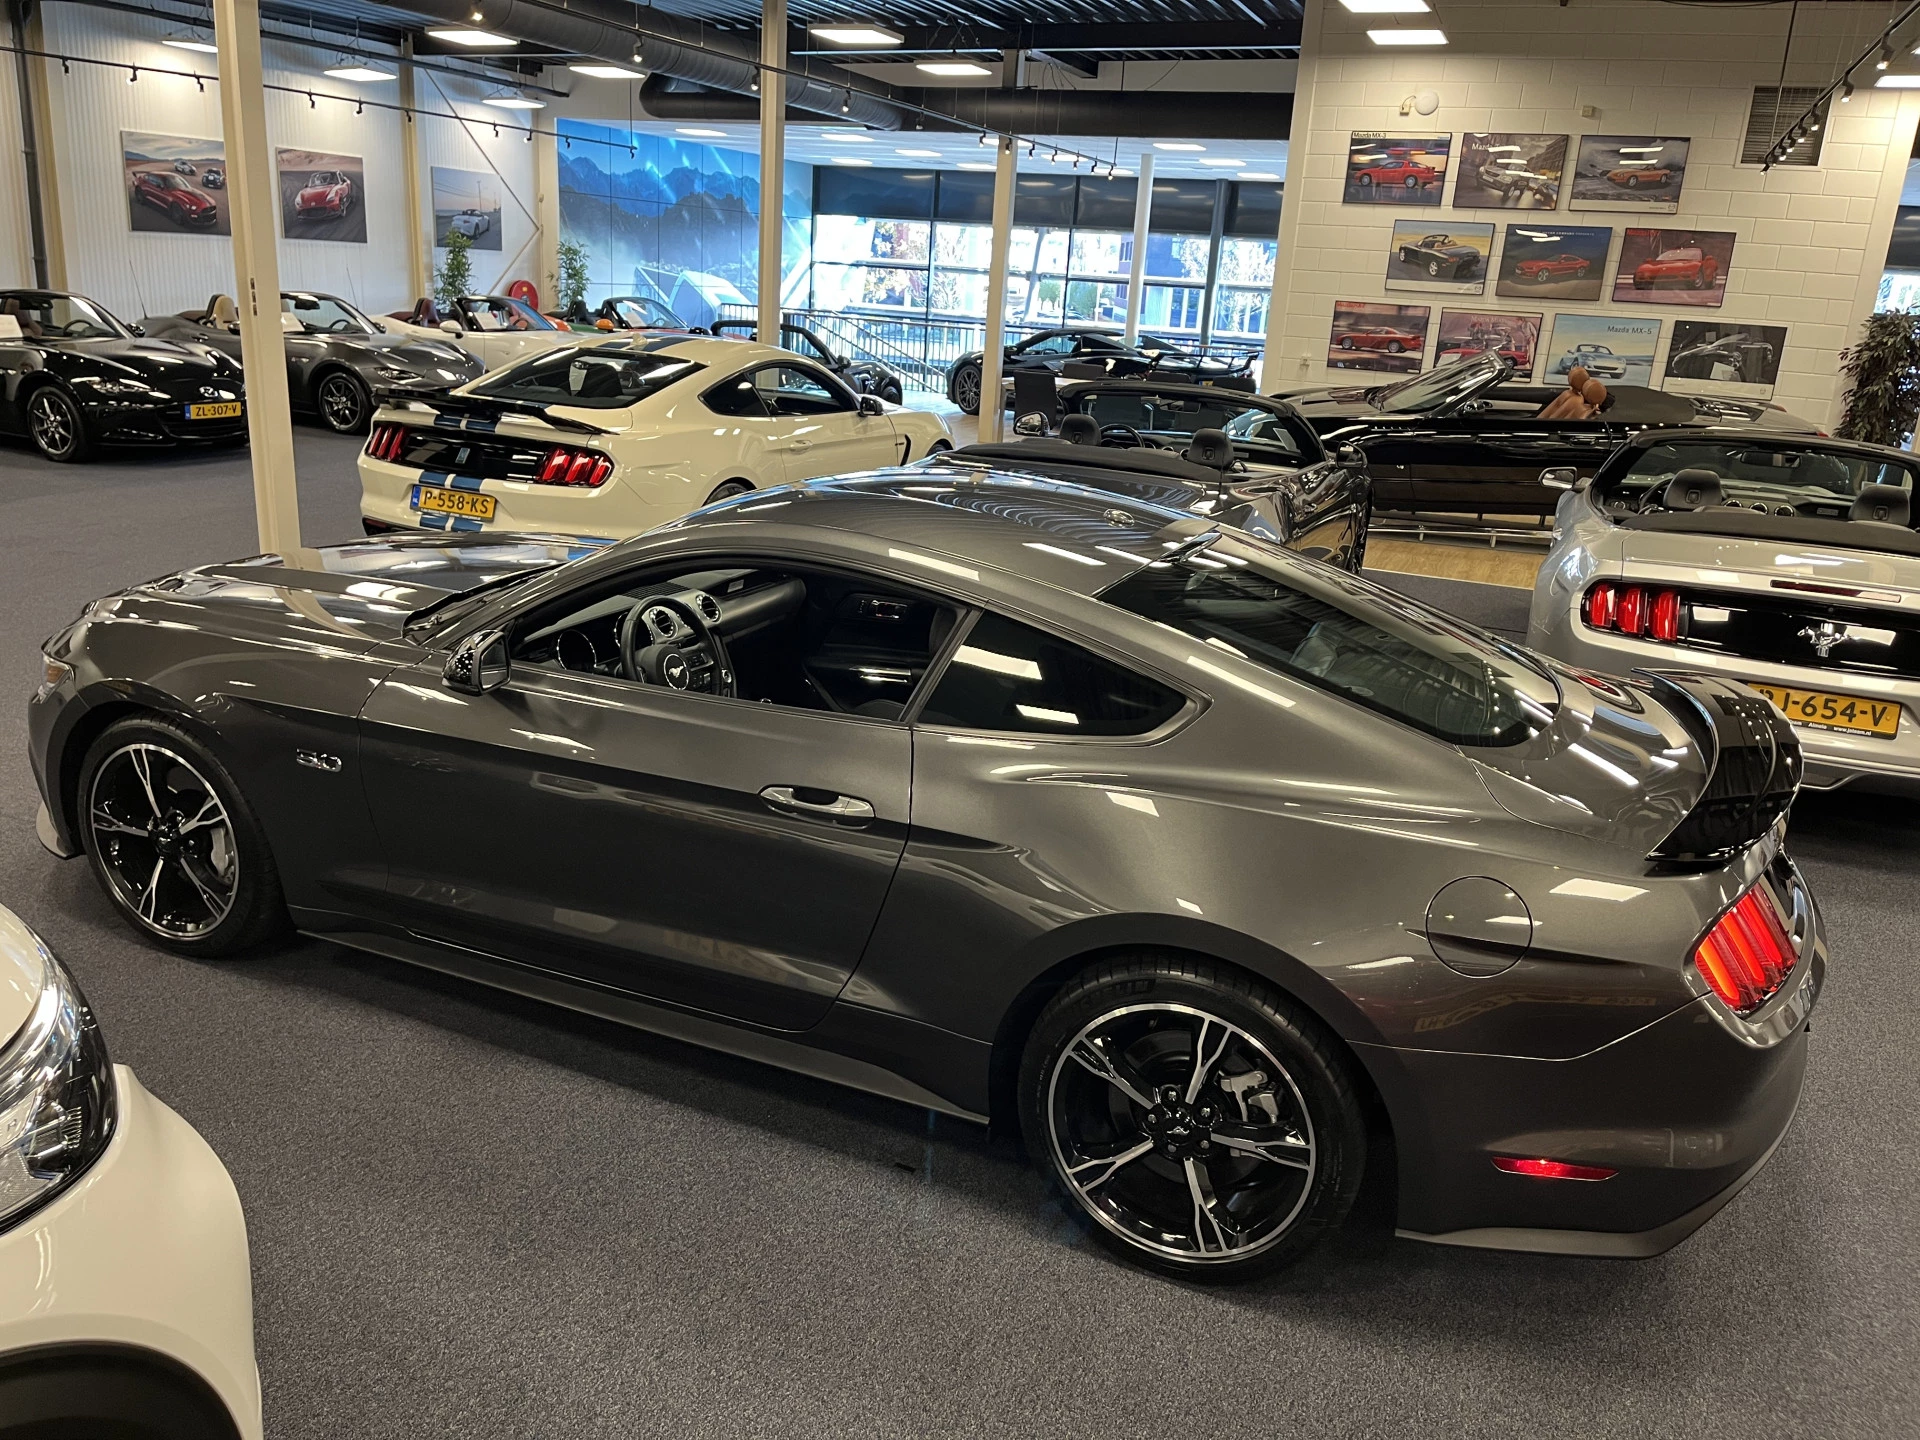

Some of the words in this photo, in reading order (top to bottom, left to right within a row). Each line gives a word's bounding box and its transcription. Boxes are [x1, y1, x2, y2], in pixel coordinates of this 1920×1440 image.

[1607, 325, 1630, 333] Mazda
[1631, 327, 1652, 335] MX-5
[195, 404, 237, 417] ZL-307-V
[423, 490, 490, 514] P-558-KS
[296, 748, 343, 773] 5.0
